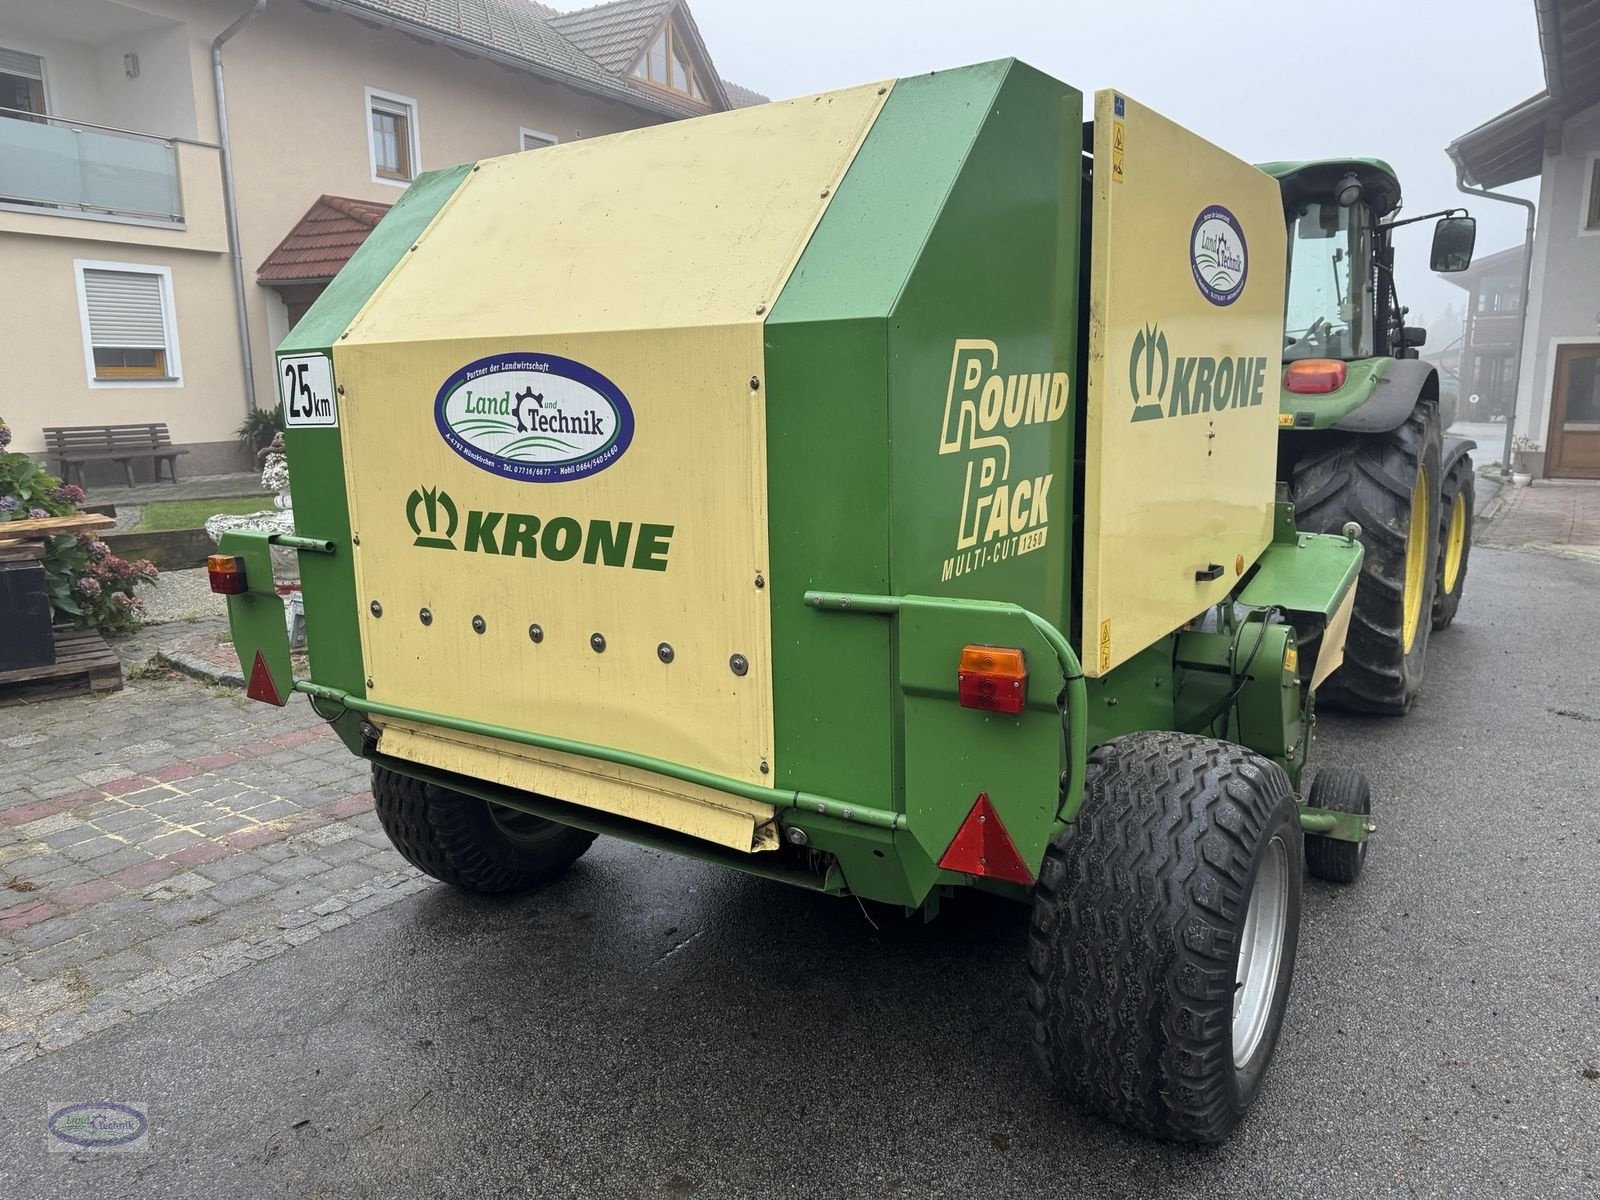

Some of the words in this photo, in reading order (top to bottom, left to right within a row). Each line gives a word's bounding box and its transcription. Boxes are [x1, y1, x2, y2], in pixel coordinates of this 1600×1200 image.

[466, 366, 488, 380] Partner
[489, 363, 500, 373] der
[501, 361, 550, 371] Landwirtschaft
[1168, 356, 1267, 418] KRONE
[465, 391, 511, 416] Land
[544, 400, 558, 409] und
[939, 338, 1070, 455] ROUND
[528, 408, 604, 436] Technik
[445, 433, 463, 452] A-4792
[463, 447, 495, 467] Münzkirchen
[560, 464, 575, 475] Mobil
[957, 435, 1054, 551] PACK
[463, 510, 675, 572] KRONE
[941, 536, 1018, 582] MULTI-CUT
[1022, 531, 1043, 552] 1250
